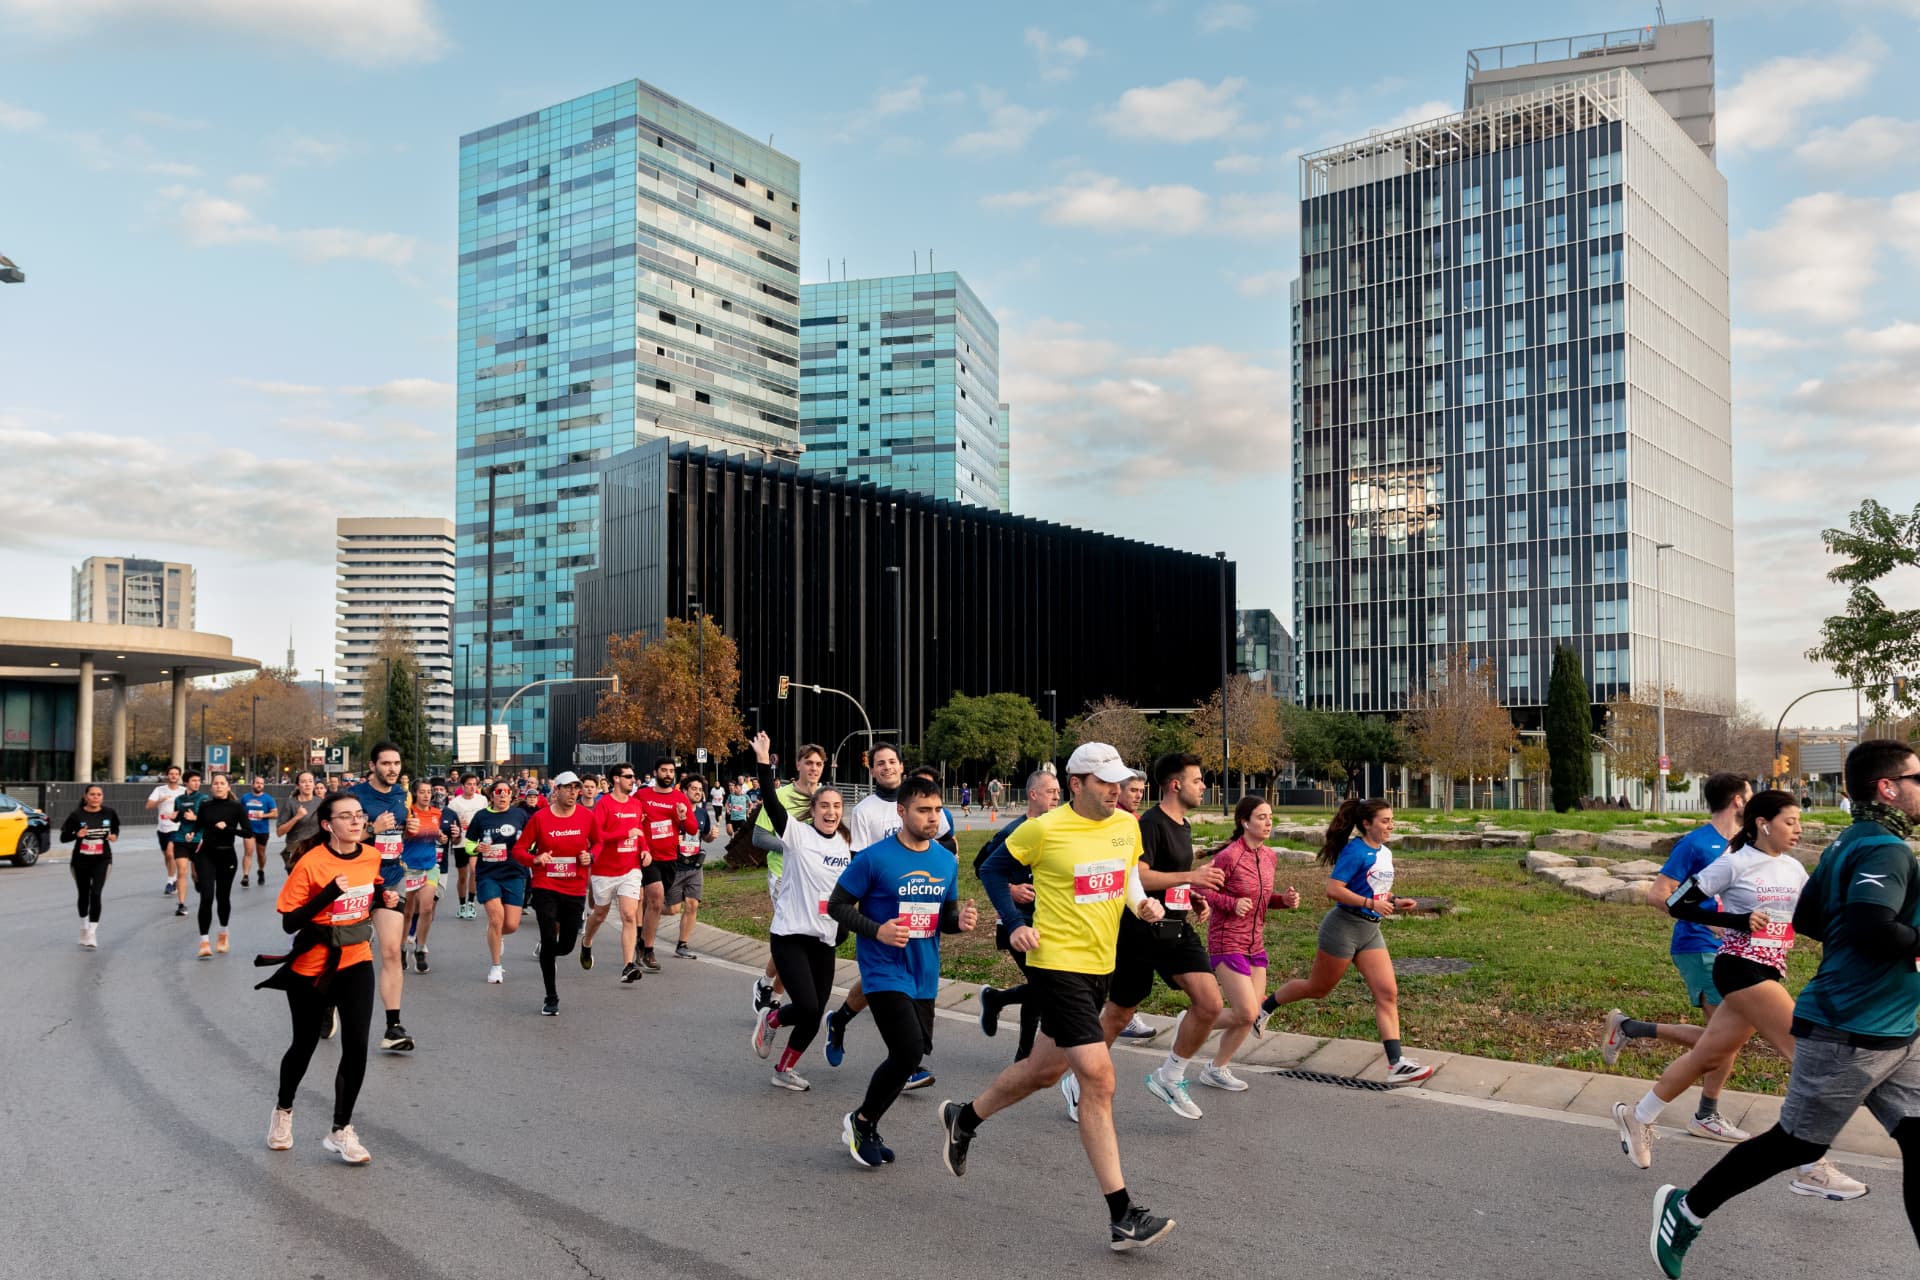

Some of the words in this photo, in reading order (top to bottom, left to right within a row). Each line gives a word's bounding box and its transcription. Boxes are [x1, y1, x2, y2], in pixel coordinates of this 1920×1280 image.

[214, 747, 223, 761] P
[332, 748, 341, 761] P
[554, 863, 568, 871] 461
[822, 855, 849, 868] KPMG
[1089, 873, 1114, 889] 678
[898, 881, 946, 896] elecnor
[342, 895, 369, 911] 1278
[910, 914, 931, 926] 956
[1766, 922, 1788, 936] 937
